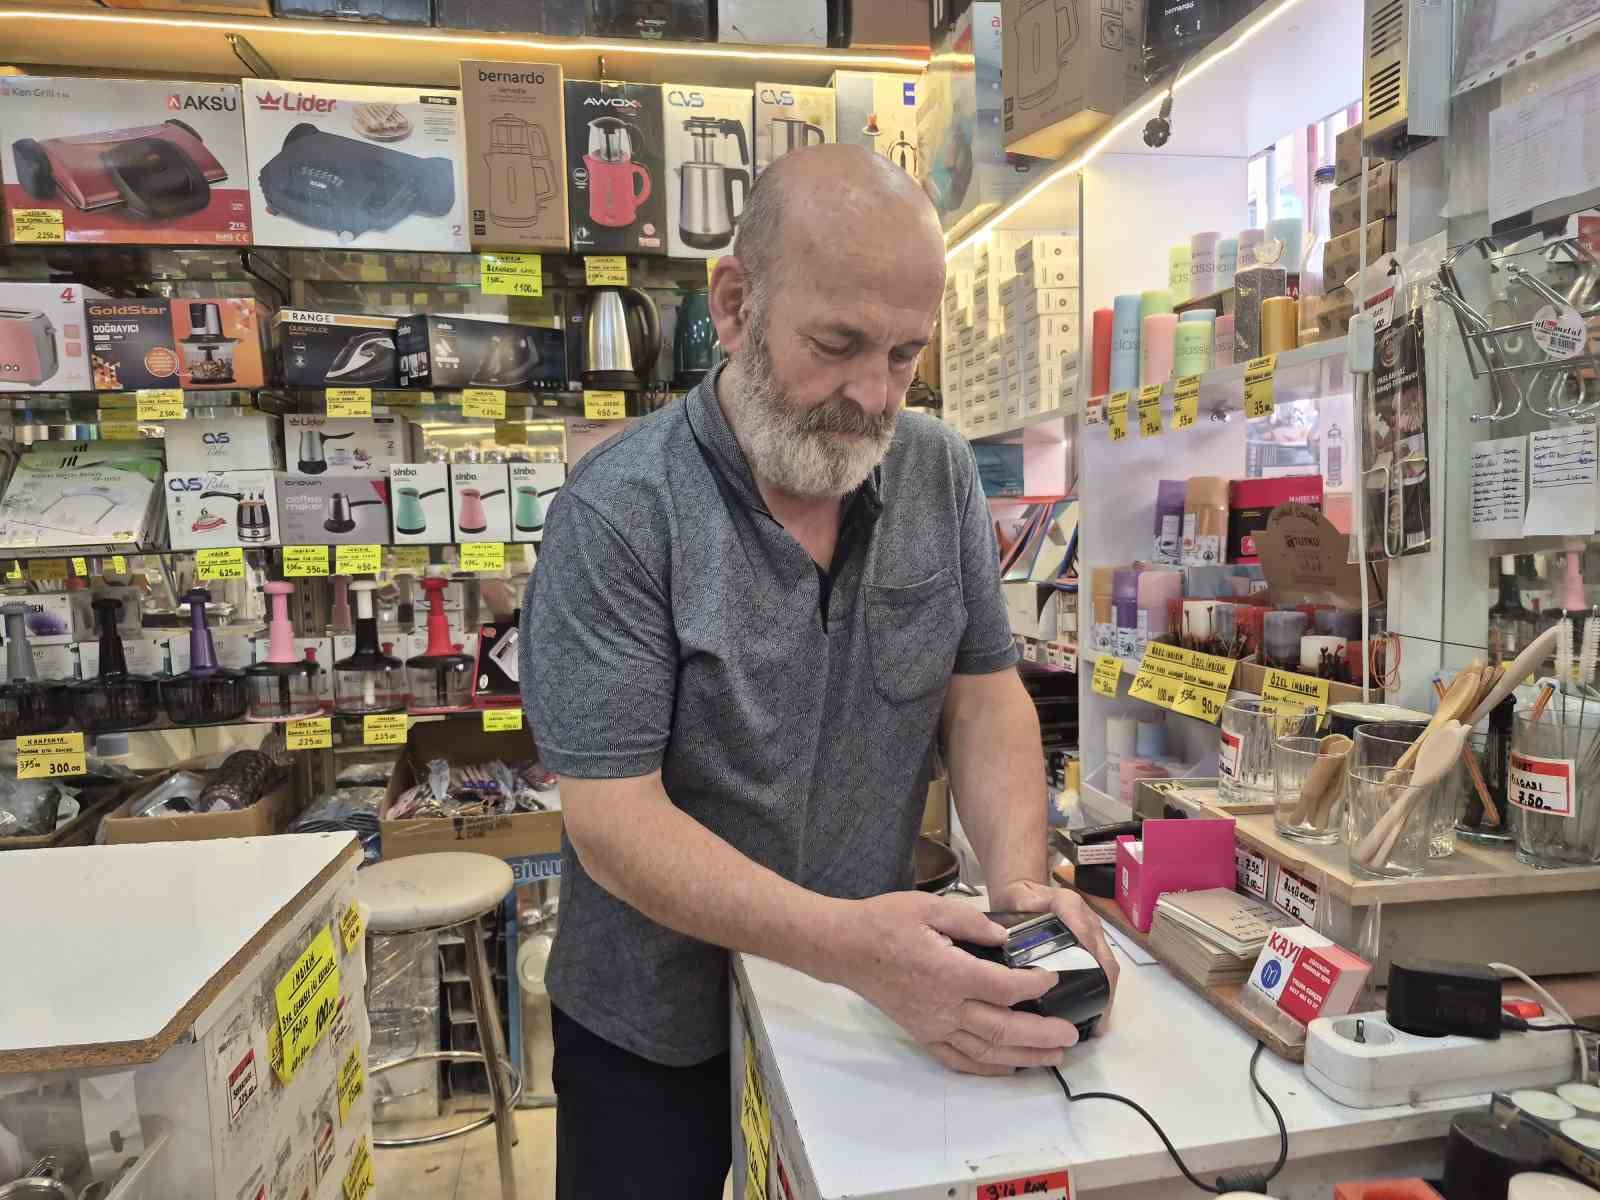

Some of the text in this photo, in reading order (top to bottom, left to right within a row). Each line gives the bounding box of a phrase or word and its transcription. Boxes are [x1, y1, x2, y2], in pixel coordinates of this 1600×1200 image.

[477, 69, 546, 85] bernardo
[182, 94, 237, 112] AKSU
[282, 92, 337, 114] Lider
[583, 97, 637, 108] AWOX
[667, 90, 705, 107] CVS
[759, 89, 795, 106] CVS
[60, 288, 76, 301] 4
[89, 305, 167, 316] GoldStar
[292, 312, 335, 322] RANGE
[92, 322, 140, 334] DOĞRAYICI
[202, 432, 230, 444] CVS
[513, 467, 536, 476] sinbo
[168, 478, 202, 492] CVS
[1270, 671, 1288, 688] ÖZEL
